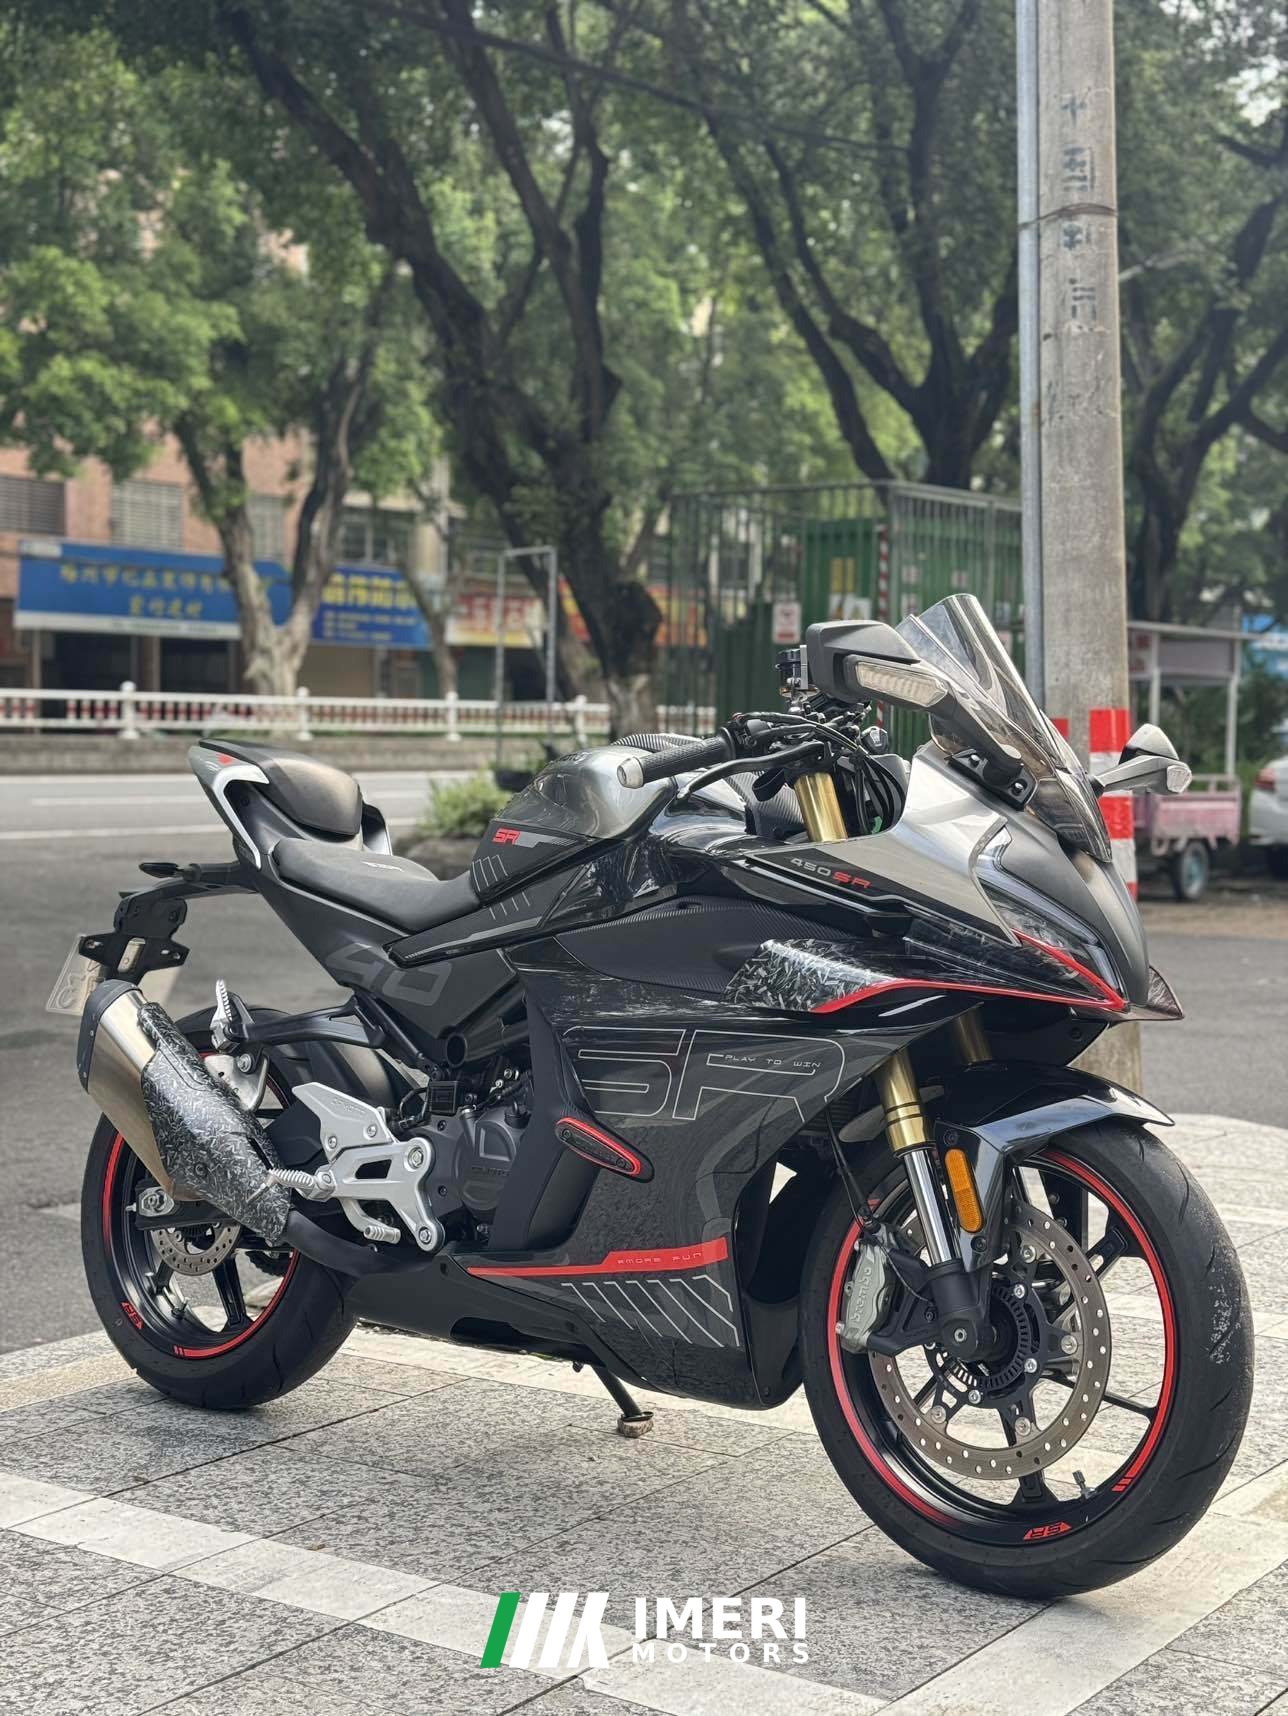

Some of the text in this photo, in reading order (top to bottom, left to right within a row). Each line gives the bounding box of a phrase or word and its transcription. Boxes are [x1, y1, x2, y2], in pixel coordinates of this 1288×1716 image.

[492, 827, 520, 846] SR
[561, 1025, 846, 1123] SR
[725, 1055, 755, 1063] PLAY
[849, 1266, 872, 1323] brembo
